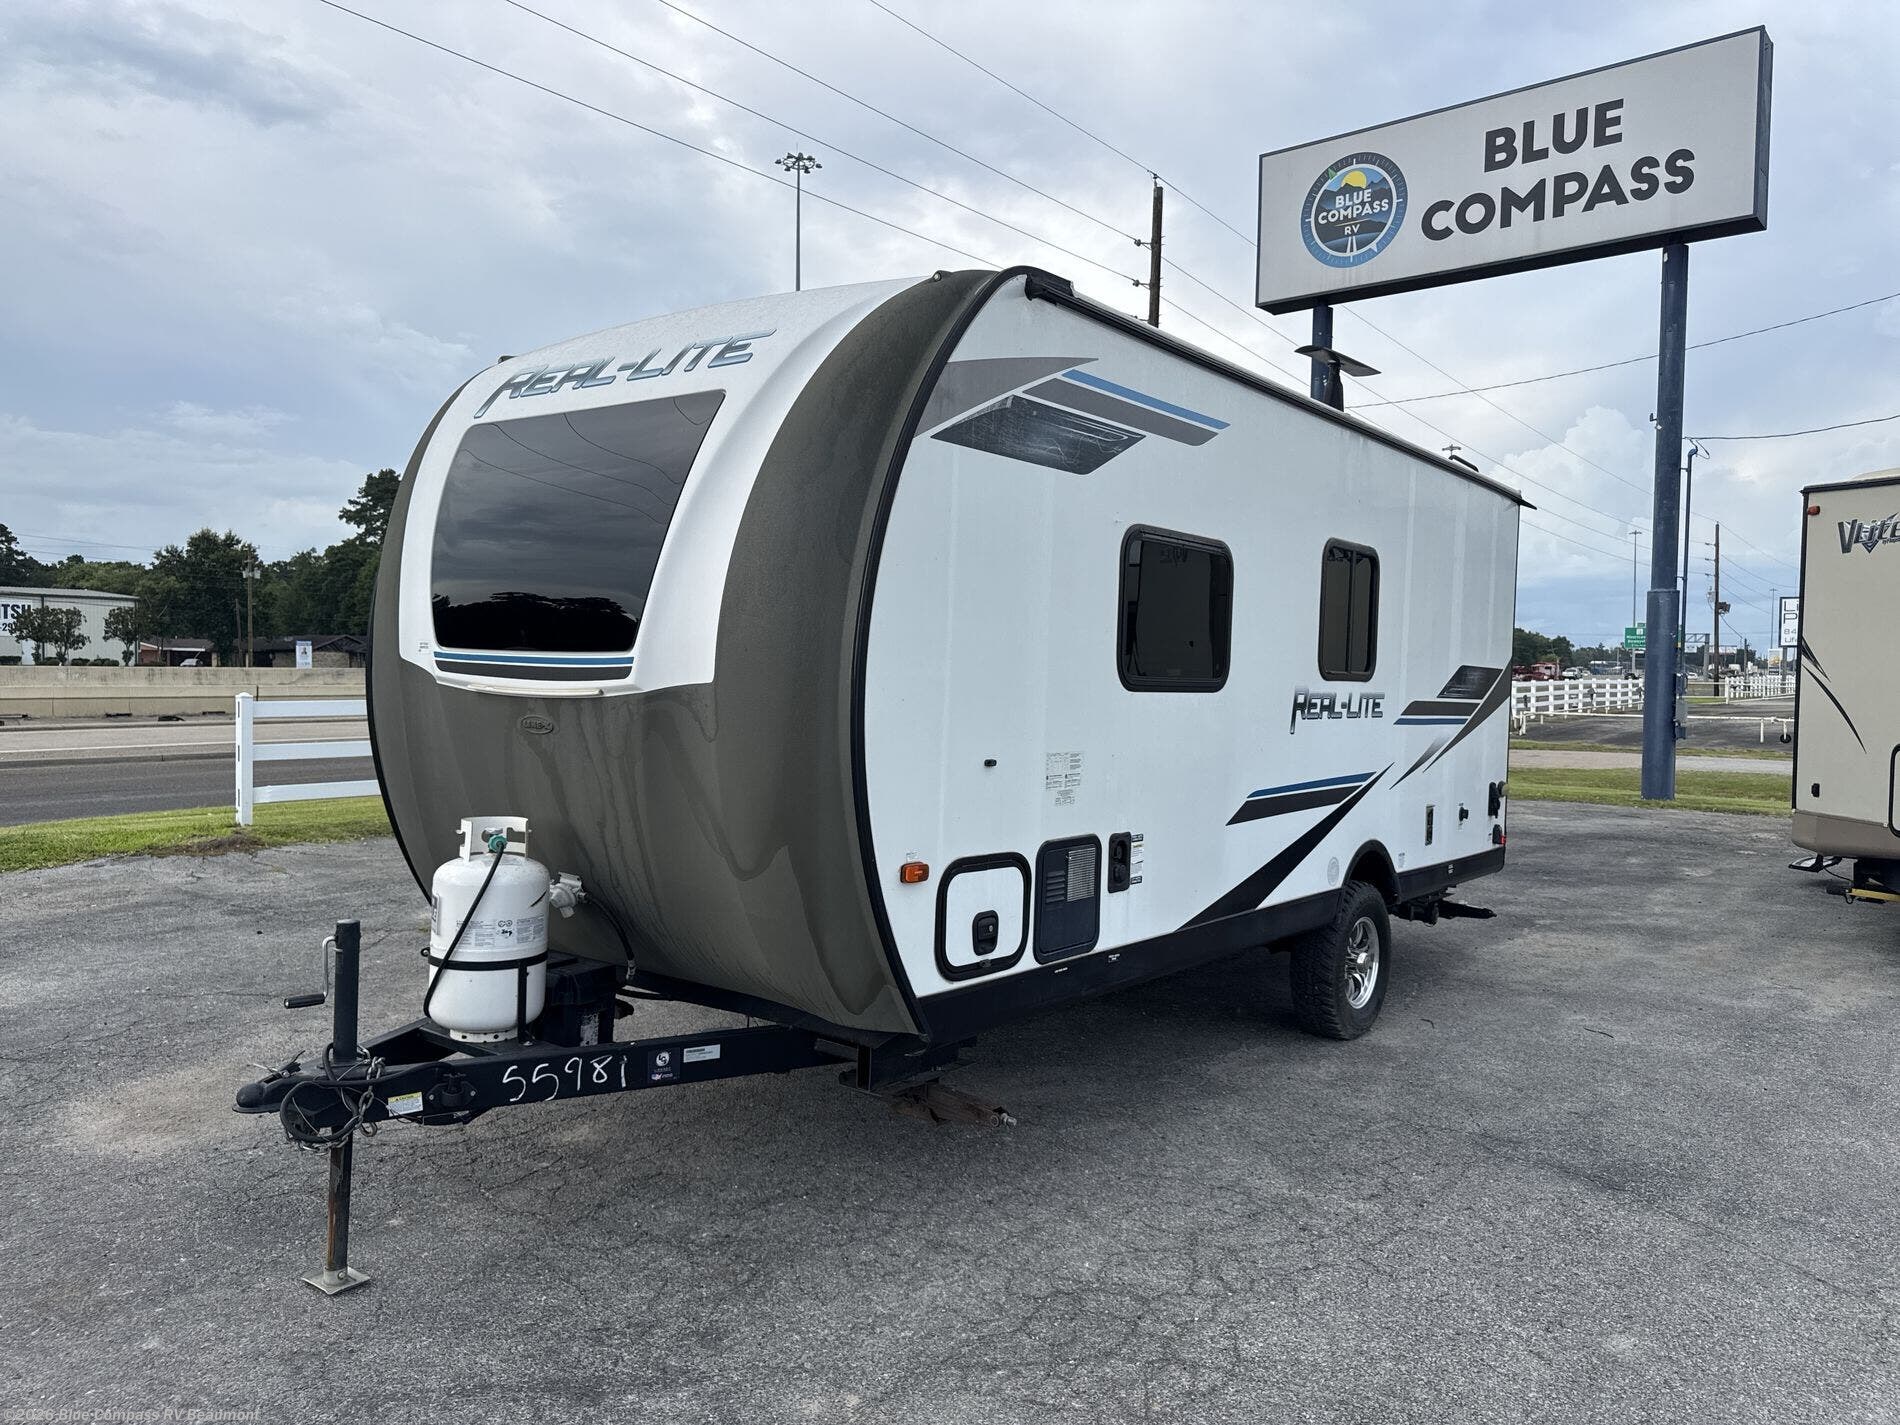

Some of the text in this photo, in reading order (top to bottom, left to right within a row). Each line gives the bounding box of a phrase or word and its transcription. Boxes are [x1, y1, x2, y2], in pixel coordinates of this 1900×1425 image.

[1484, 98, 1624, 172] BLUE
[1318, 199, 1389, 224] COMPASS
[1335, 188, 1372, 208] BLUE
[1421, 149, 1695, 241] COMPASS
[1344, 224, 1360, 235] RV
[474, 329, 777, 419] REAL-LITE
[1290, 686, 1385, 734] REAL-LITE
[502, 1055, 627, 1101] 55981
